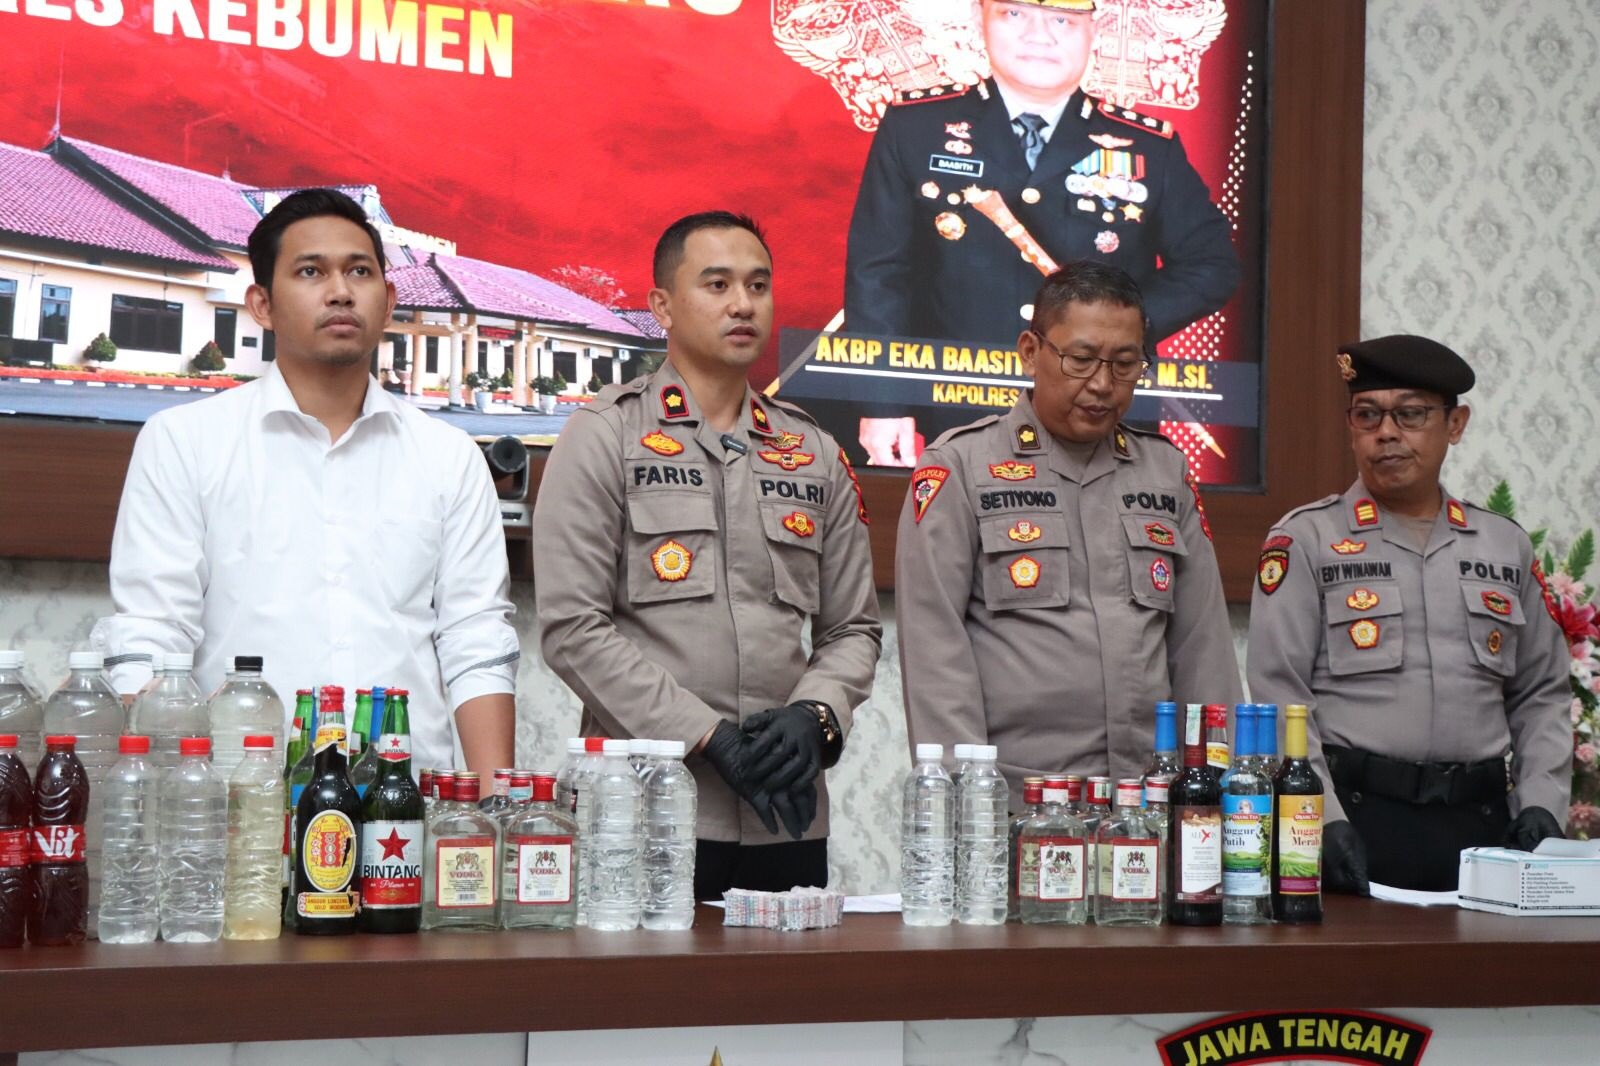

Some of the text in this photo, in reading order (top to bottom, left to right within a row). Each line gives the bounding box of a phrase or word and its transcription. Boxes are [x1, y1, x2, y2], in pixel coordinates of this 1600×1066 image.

[153, 0, 513, 79] KEBUMEN
[815, 336, 882, 365] AKBP
[889, 342, 935, 370] EKA
[932, 383, 1018, 407] KAPOLRES
[634, 465, 704, 487] FARIS
[760, 479, 824, 505] POLRI
[980, 490, 1057, 510] SETIYOKO
[1122, 491, 1176, 514] POLRI
[1321, 563, 1340, 583] EDY
[1459, 560, 1520, 585] POLRI
[34, 826, 80, 858] Vit
[363, 864, 421, 878] BINTANG
[1182, 1018, 1410, 1066] JAWA TENGAH
